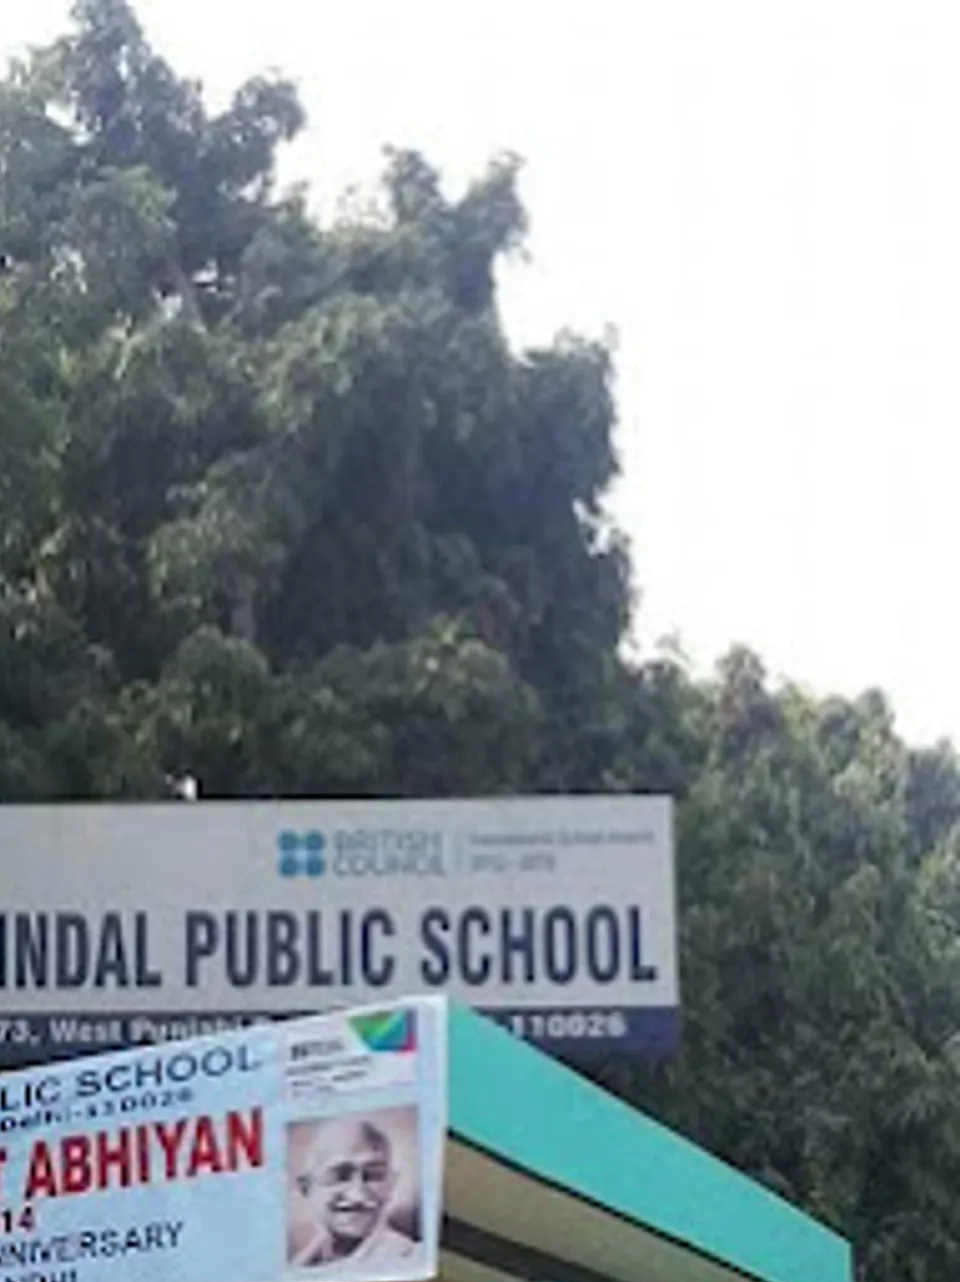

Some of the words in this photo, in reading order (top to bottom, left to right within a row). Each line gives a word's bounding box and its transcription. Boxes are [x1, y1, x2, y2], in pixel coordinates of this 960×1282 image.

[184, 909, 396, 987] PUBLIC
[420, 904, 659, 986] SCHOOL
[49, 1018, 122, 1043] West
[512, 1012, 628, 1038] 110026
[74, 1044, 264, 1098] SCHOOL
[24, 1106, 264, 1200] ABHIYAN
